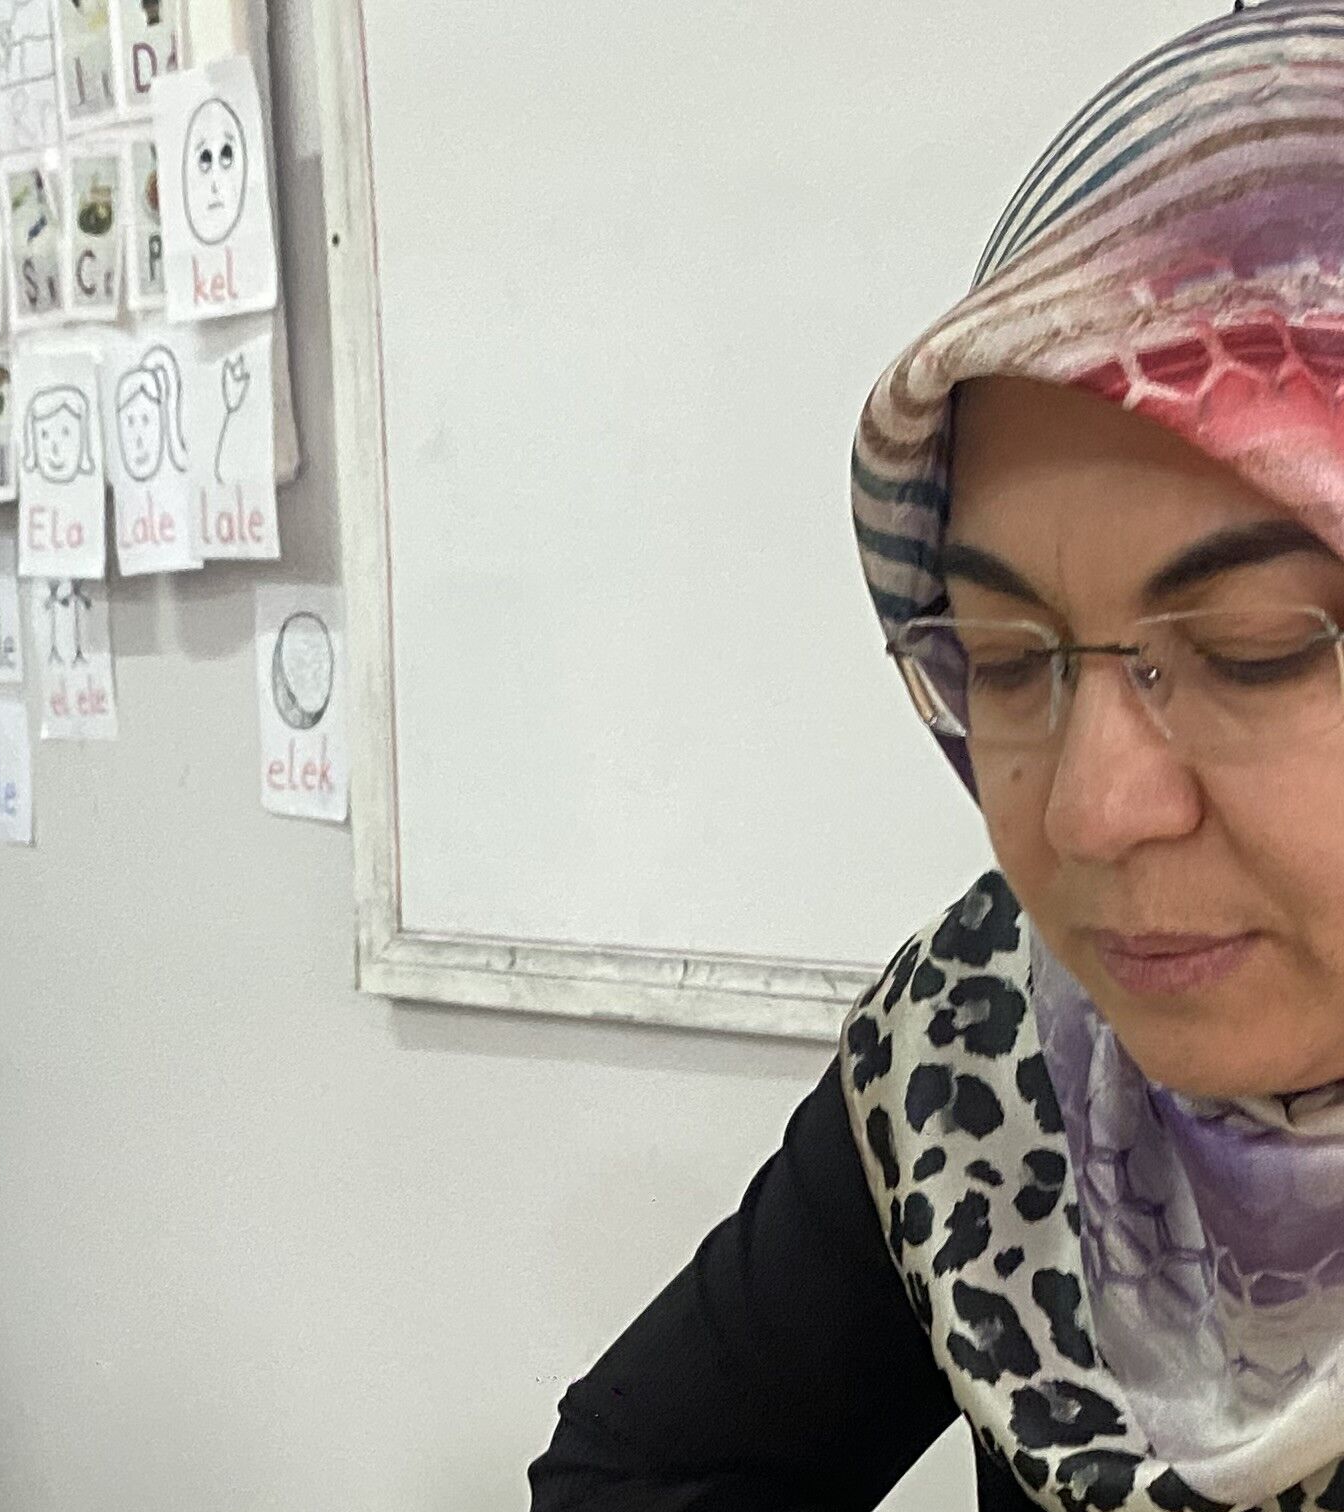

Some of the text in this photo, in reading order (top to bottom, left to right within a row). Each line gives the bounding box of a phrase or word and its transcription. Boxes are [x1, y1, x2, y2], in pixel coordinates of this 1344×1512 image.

[191, 246, 239, 305] kel
[27, 506, 85, 551] Ela
[200, 484, 265, 546] lale
[266, 734, 335, 793] elek
